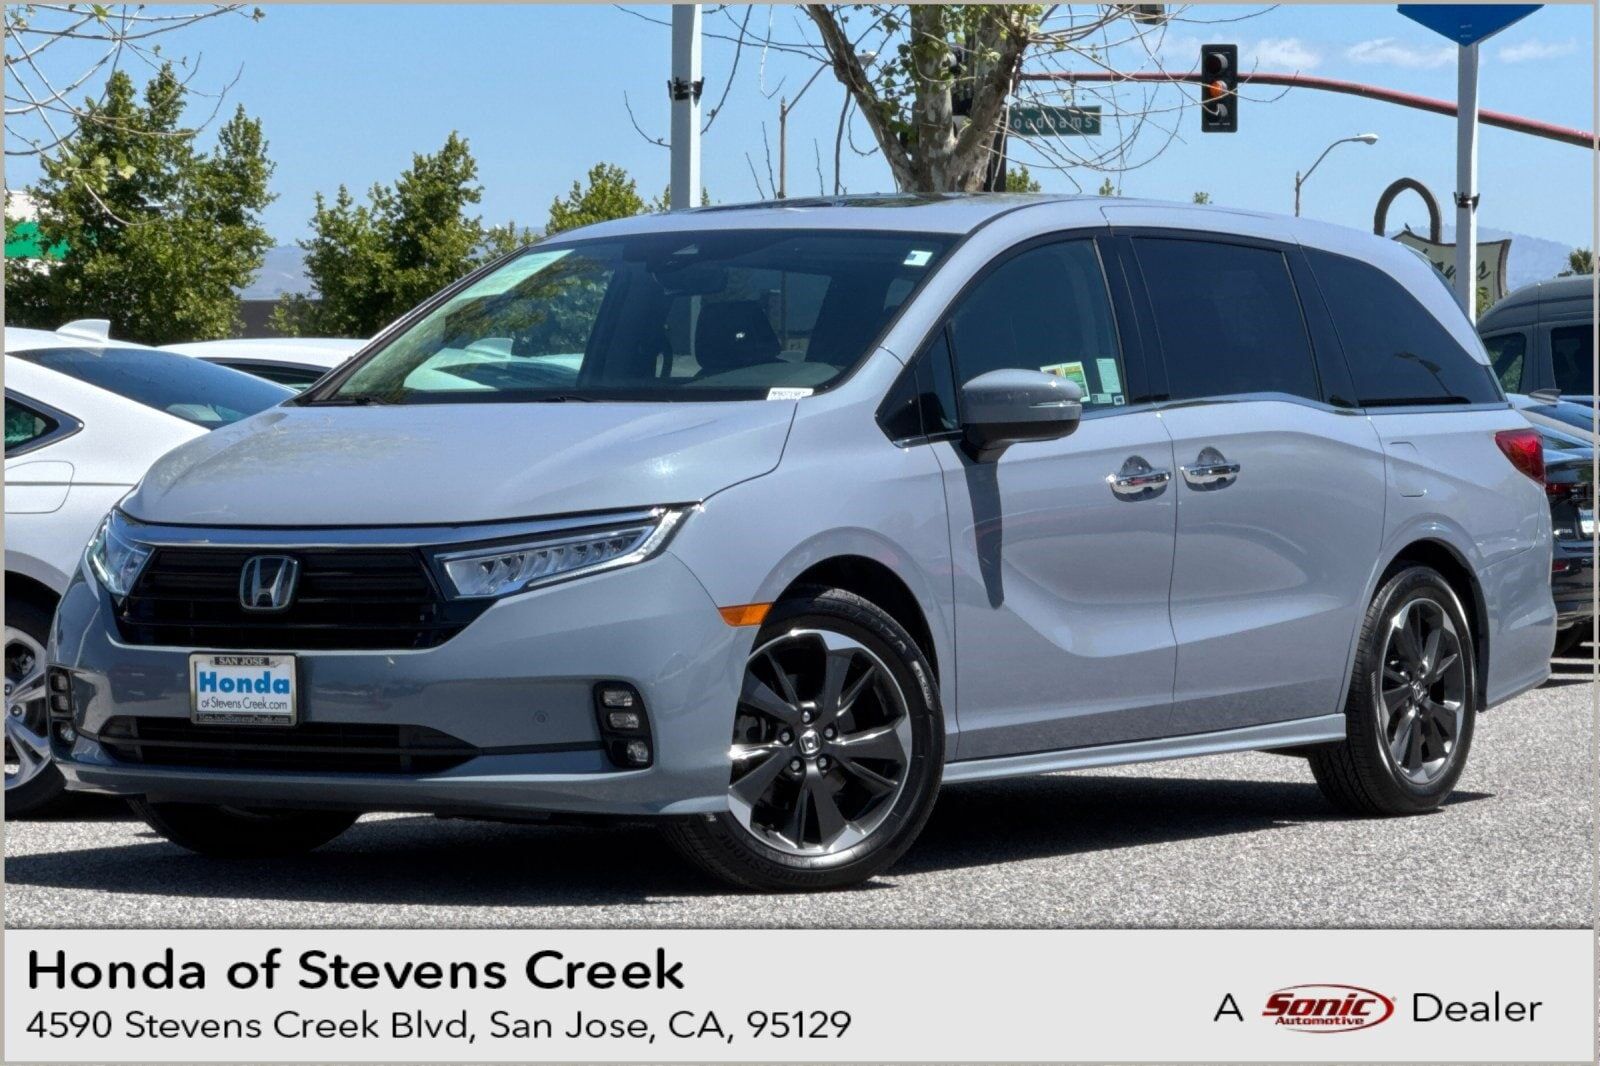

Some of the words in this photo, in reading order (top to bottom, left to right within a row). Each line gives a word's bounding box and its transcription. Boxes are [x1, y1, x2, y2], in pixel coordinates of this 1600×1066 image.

[1009, 115, 1093, 129] oodhams
[219, 657, 238, 665] SAN
[240, 657, 265, 666] JOSE
[199, 670, 290, 694] Honda
[201, 698, 210, 708] of
[211, 696, 242, 709] Stevens
[242, 696, 287, 710] Creek.com
